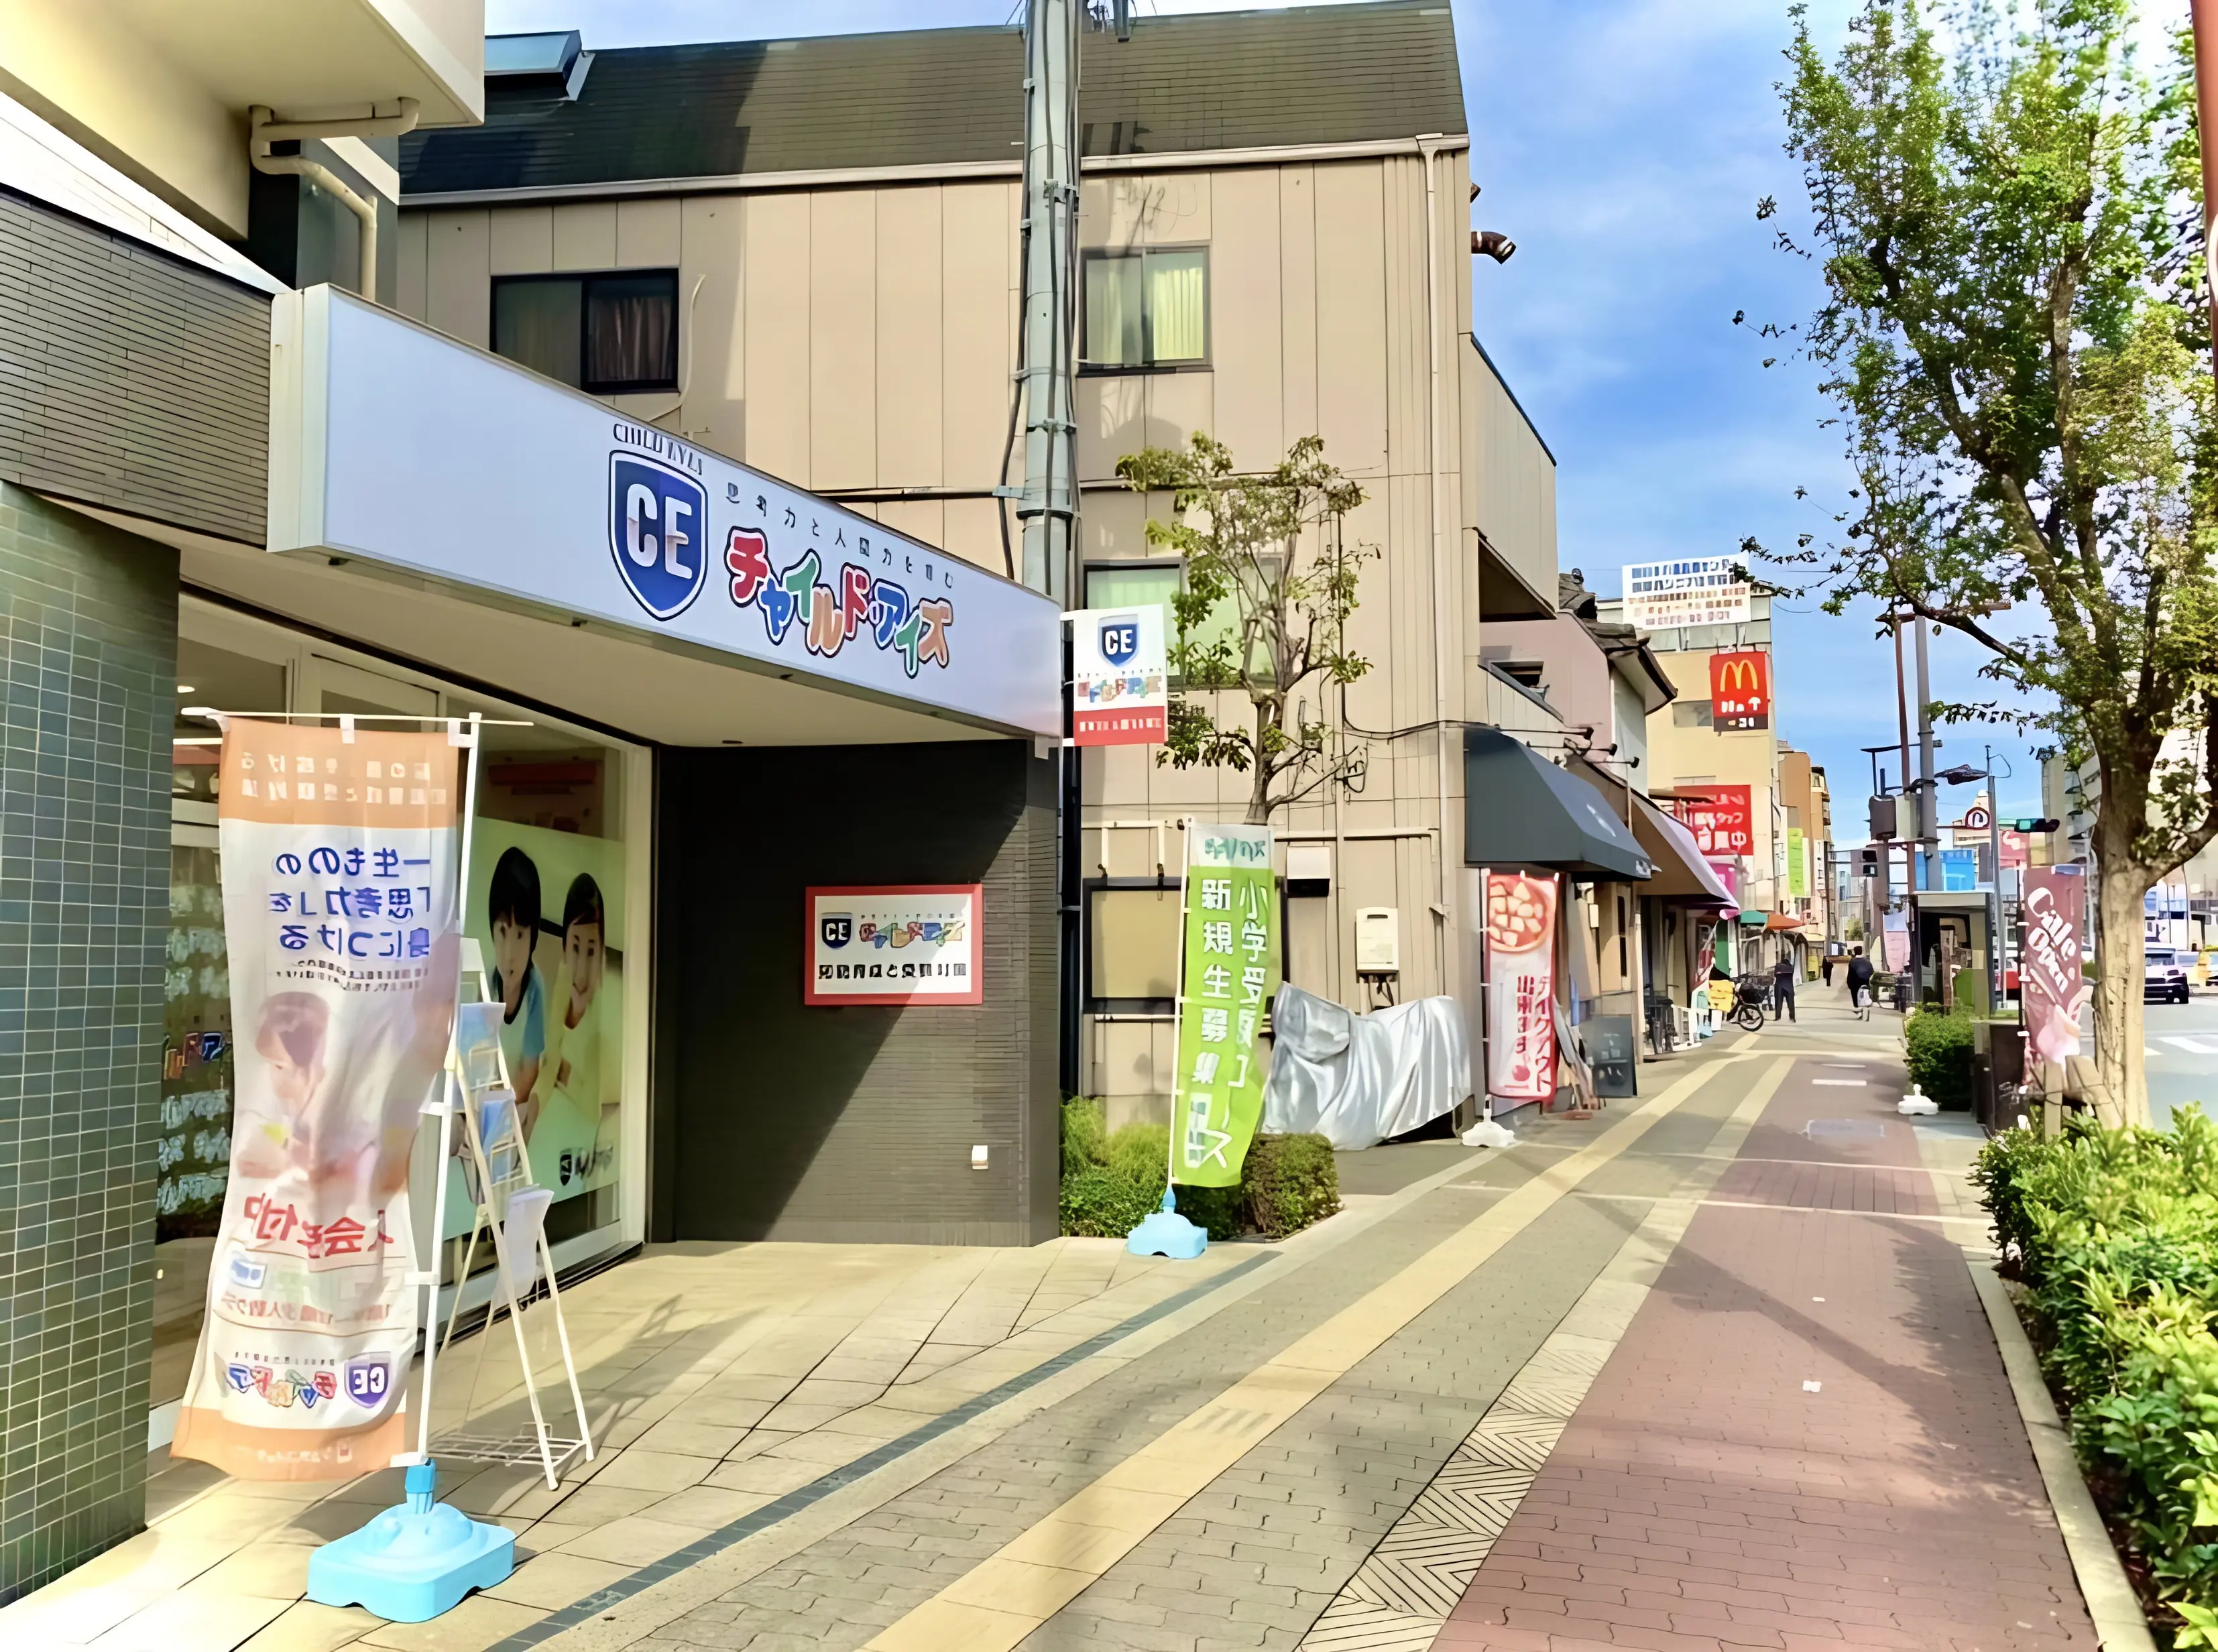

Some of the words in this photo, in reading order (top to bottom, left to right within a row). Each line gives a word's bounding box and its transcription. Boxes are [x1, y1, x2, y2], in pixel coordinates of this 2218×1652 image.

[626, 483, 693, 580] CE
[1105, 629, 1133, 655] CE
[825, 922, 849, 941] CE
